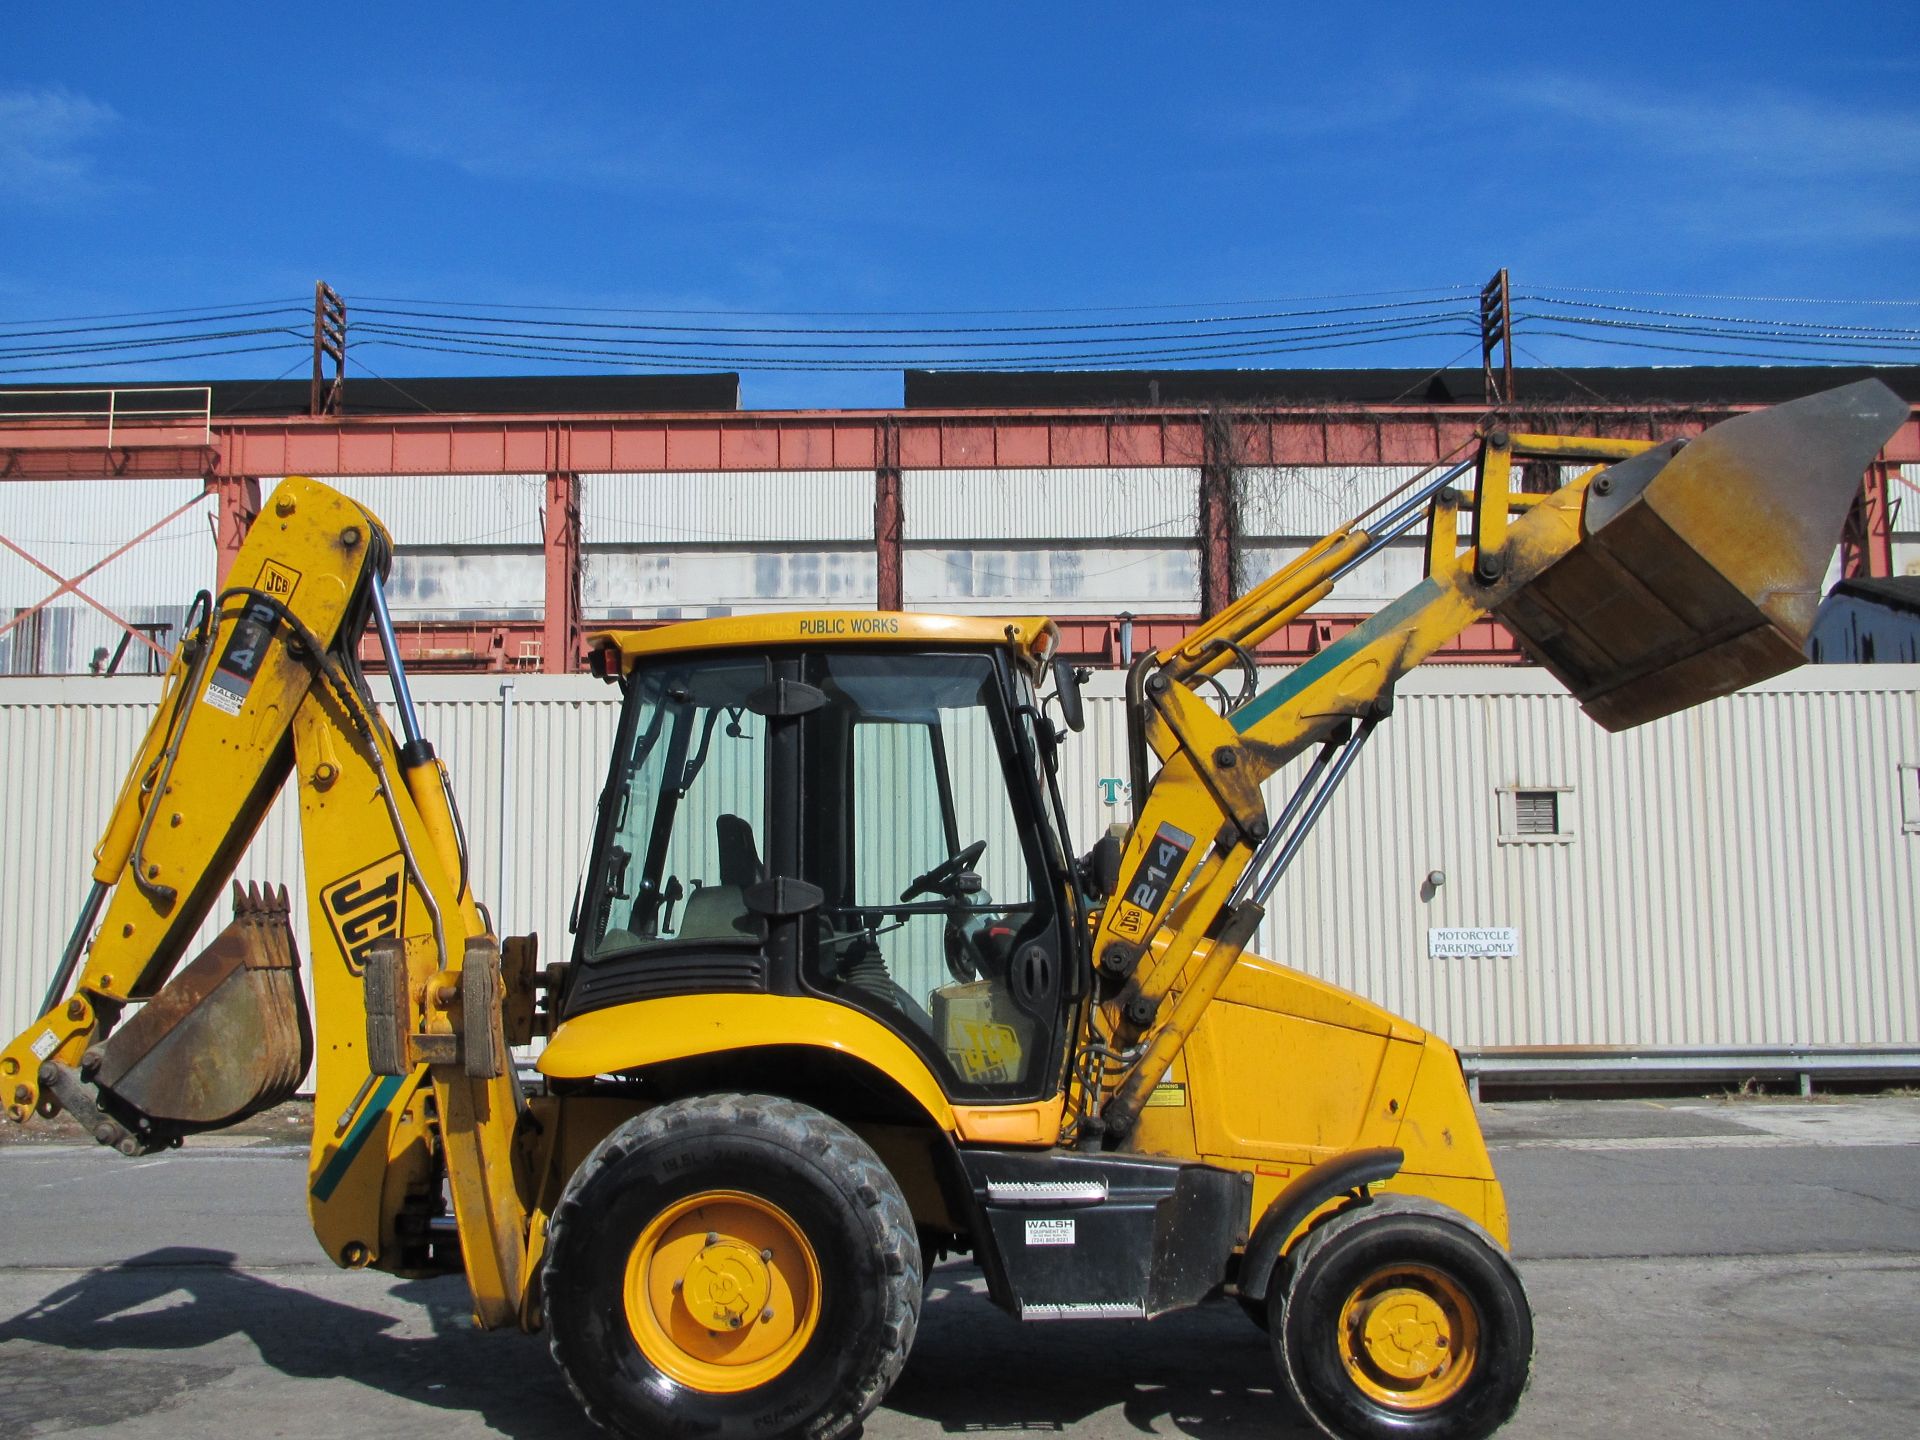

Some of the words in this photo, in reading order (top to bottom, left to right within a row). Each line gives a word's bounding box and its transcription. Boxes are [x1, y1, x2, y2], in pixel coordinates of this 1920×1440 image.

[266, 571, 289, 593] JCB
[800, 619, 845, 634] PUBLIC
[850, 618, 899, 633] WORKS
[209, 684, 244, 703] WALSH
[1133, 842, 1178, 909] 214
[1120, 910, 1140, 932] JCB
[1437, 931, 1511, 940] MOTORCYCLE
[1434, 943, 1482, 953] PARKING
[1486, 943, 1514, 952] ONLY
[1027, 1220, 1073, 1228] WALSH
